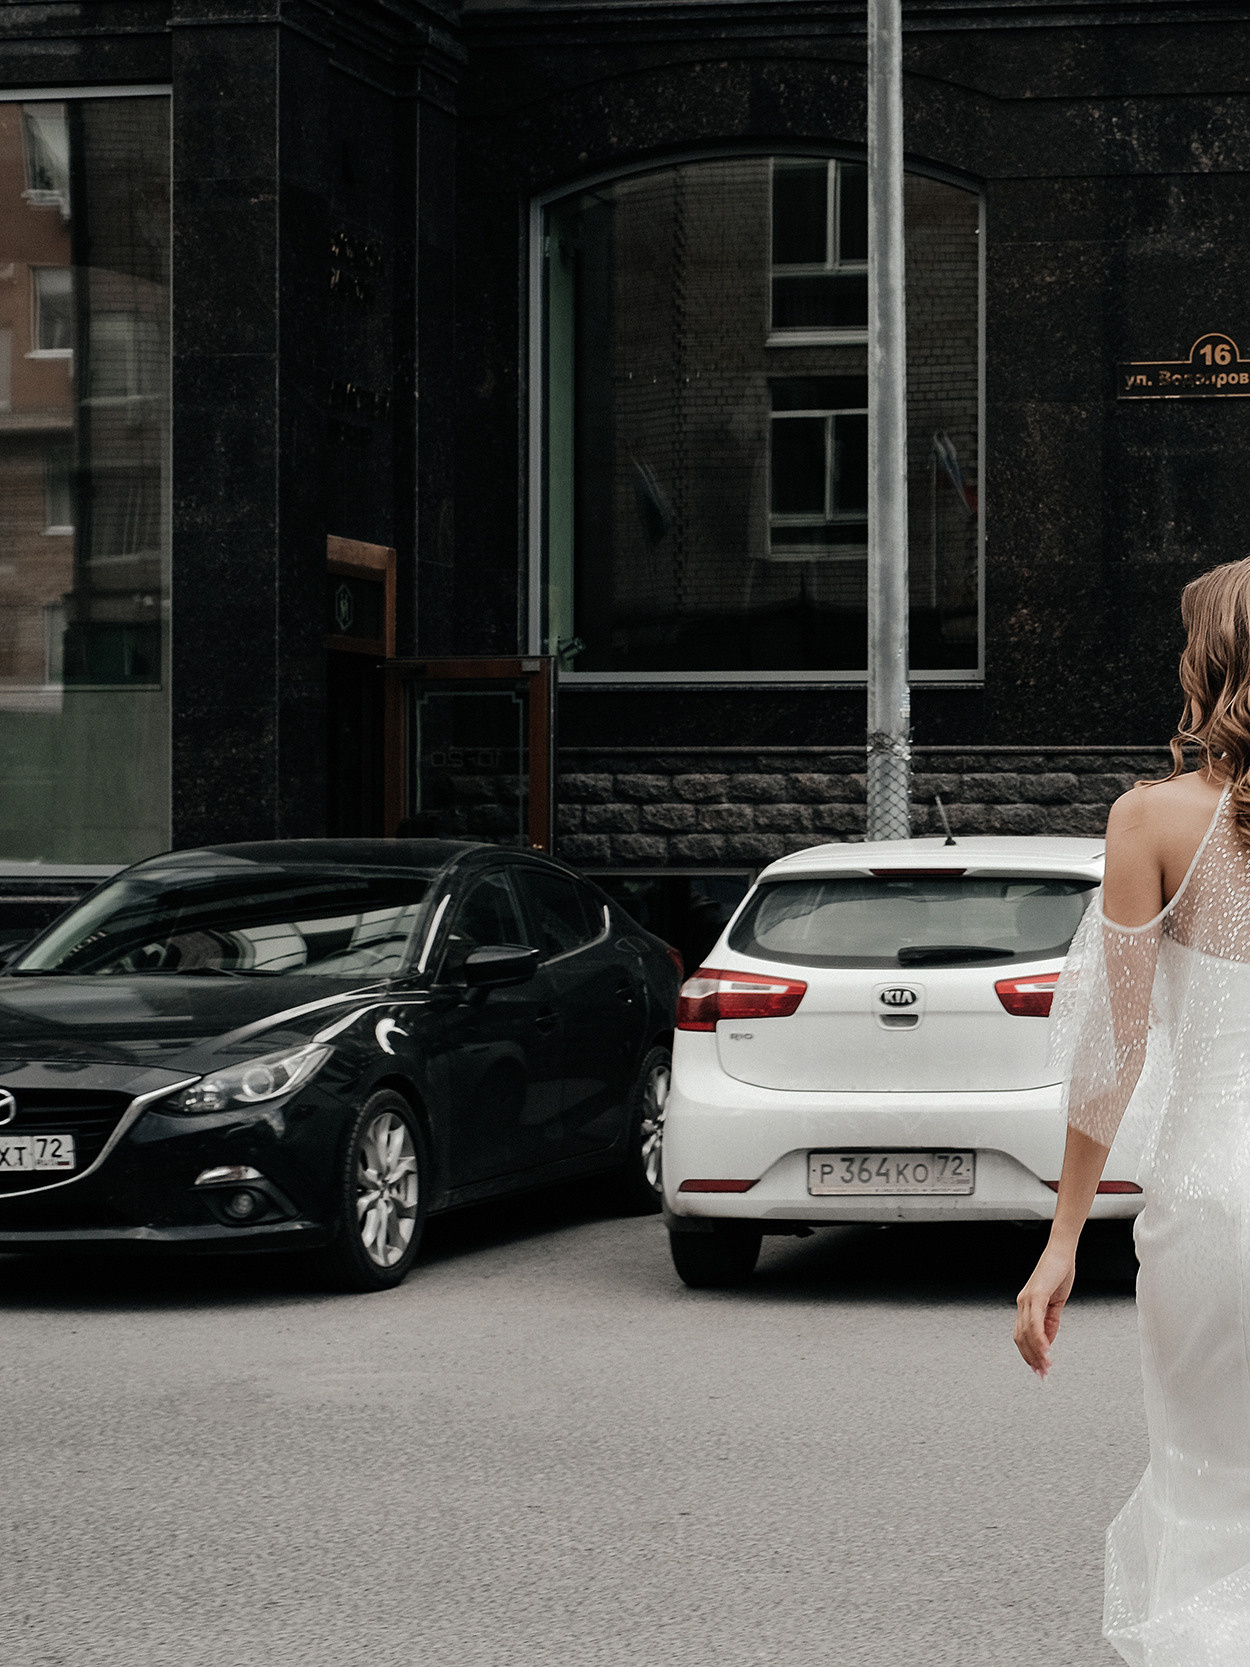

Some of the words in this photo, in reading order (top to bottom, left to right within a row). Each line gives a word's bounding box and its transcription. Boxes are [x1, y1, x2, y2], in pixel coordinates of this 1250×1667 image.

[1199, 343, 1232, 366] 16
[1124, 374, 1153, 391] ул.
[883, 989, 914, 1004] KIA
[36, 1137, 63, 1158] 72
[936, 1155, 964, 1176] 72
